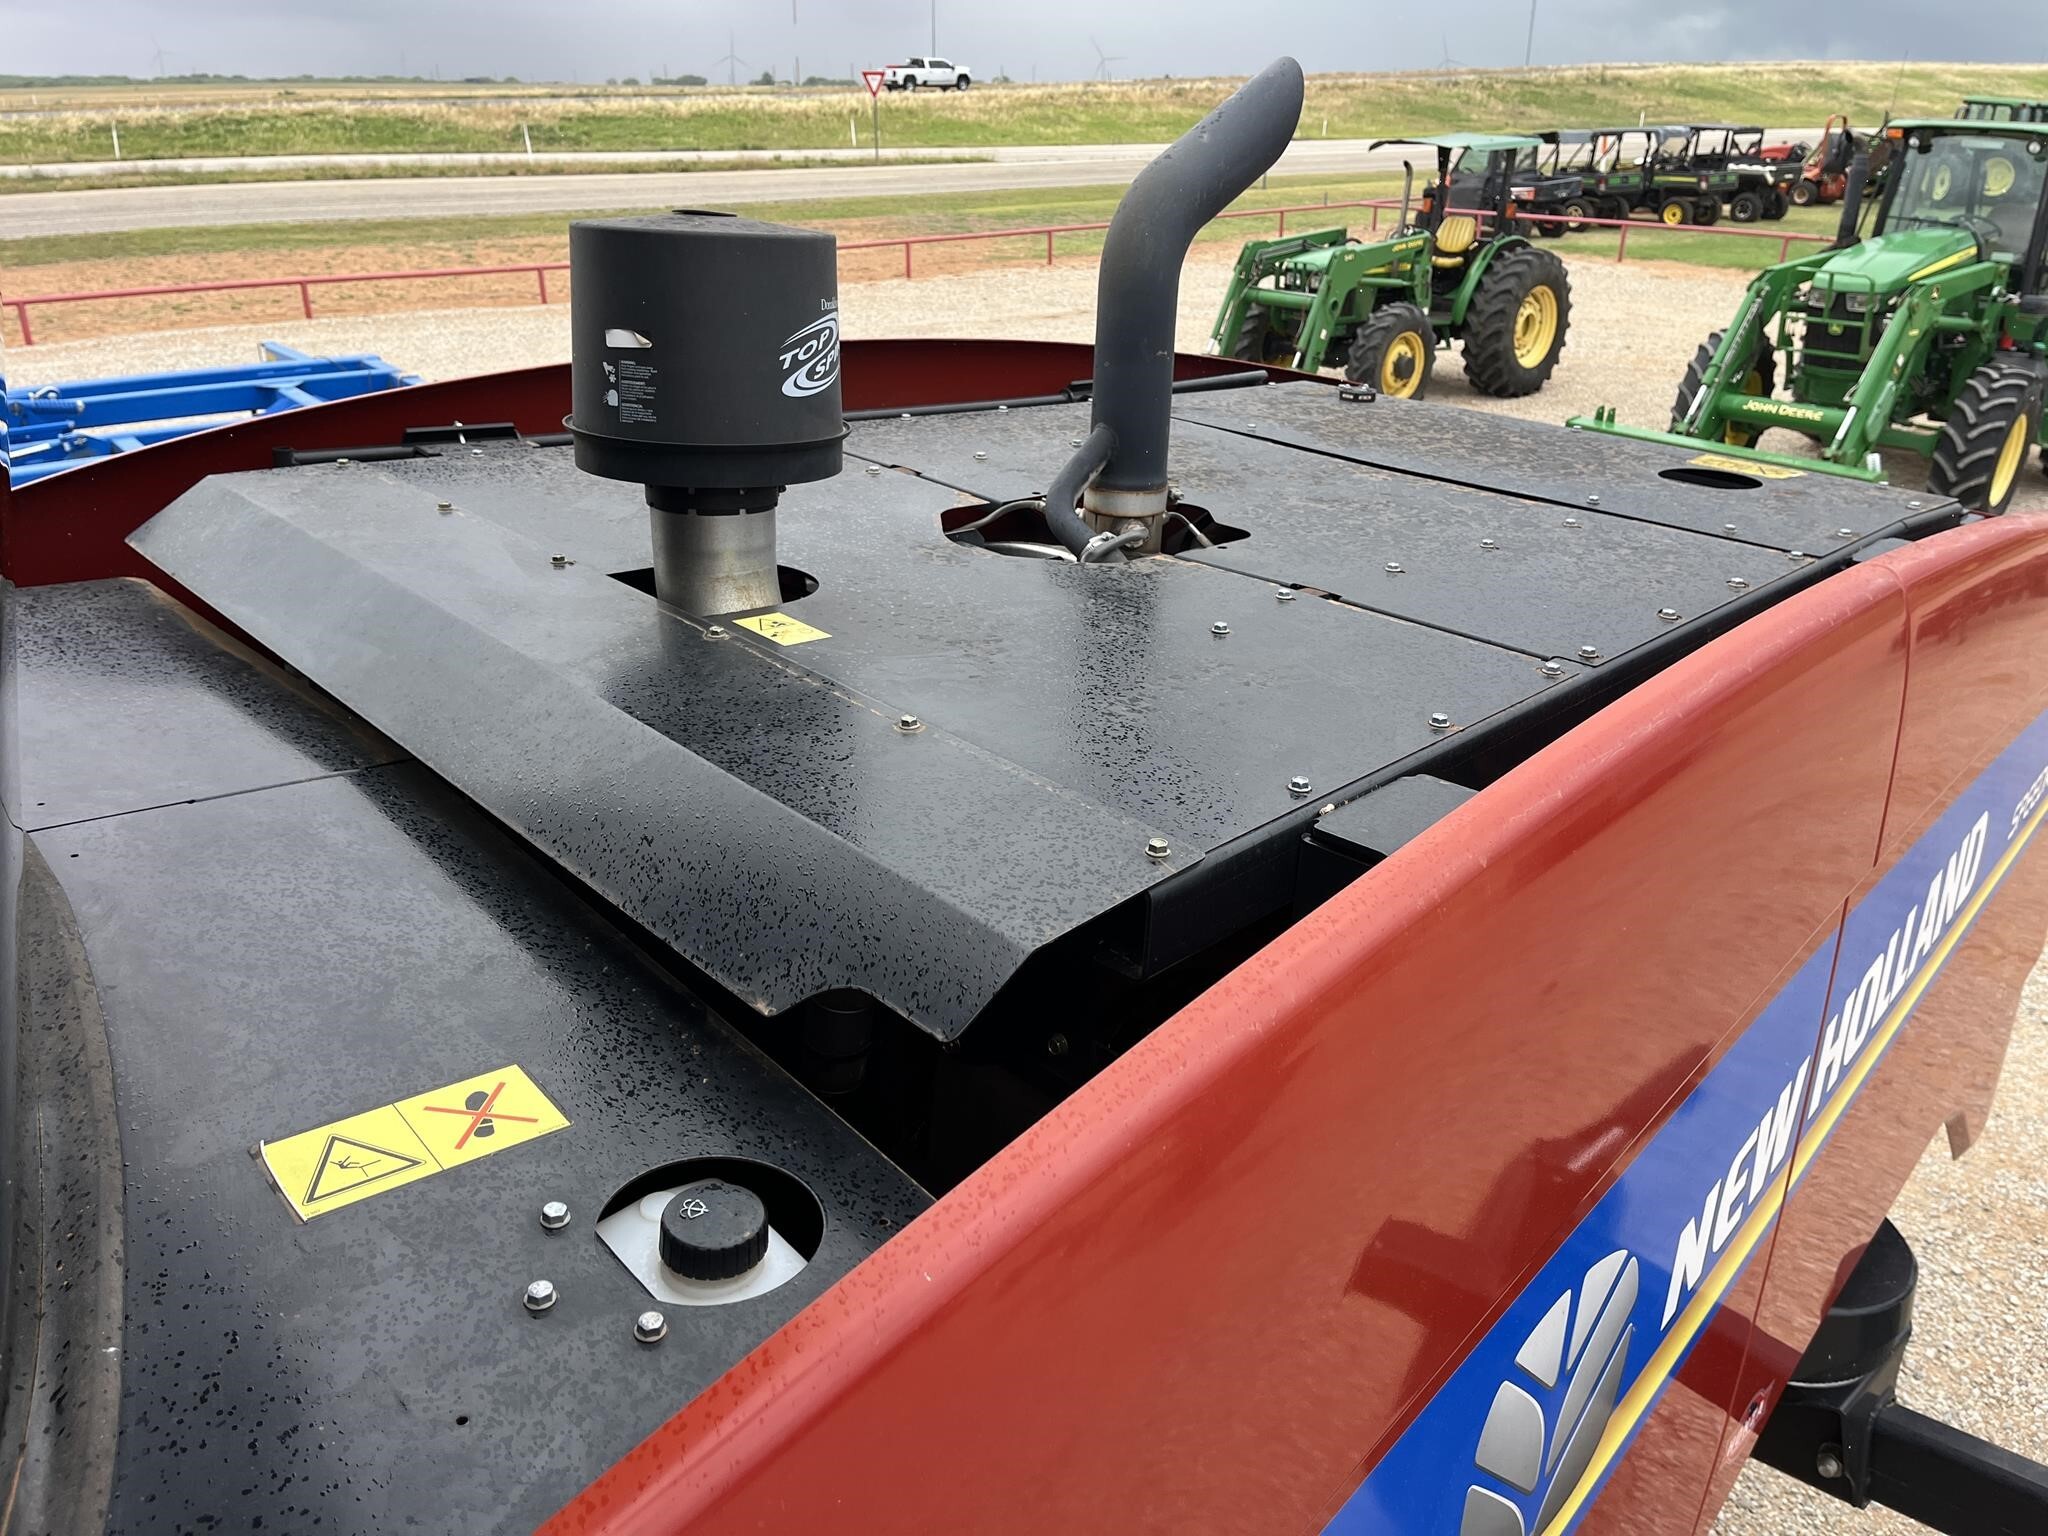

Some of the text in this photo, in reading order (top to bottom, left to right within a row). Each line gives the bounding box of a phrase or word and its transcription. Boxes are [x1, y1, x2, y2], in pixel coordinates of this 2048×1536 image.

[779, 329, 830, 370] TOP
[1742, 400, 1824, 421] JOHN DEERE
[1660, 810, 1989, 1331] NEW HOLLAND
